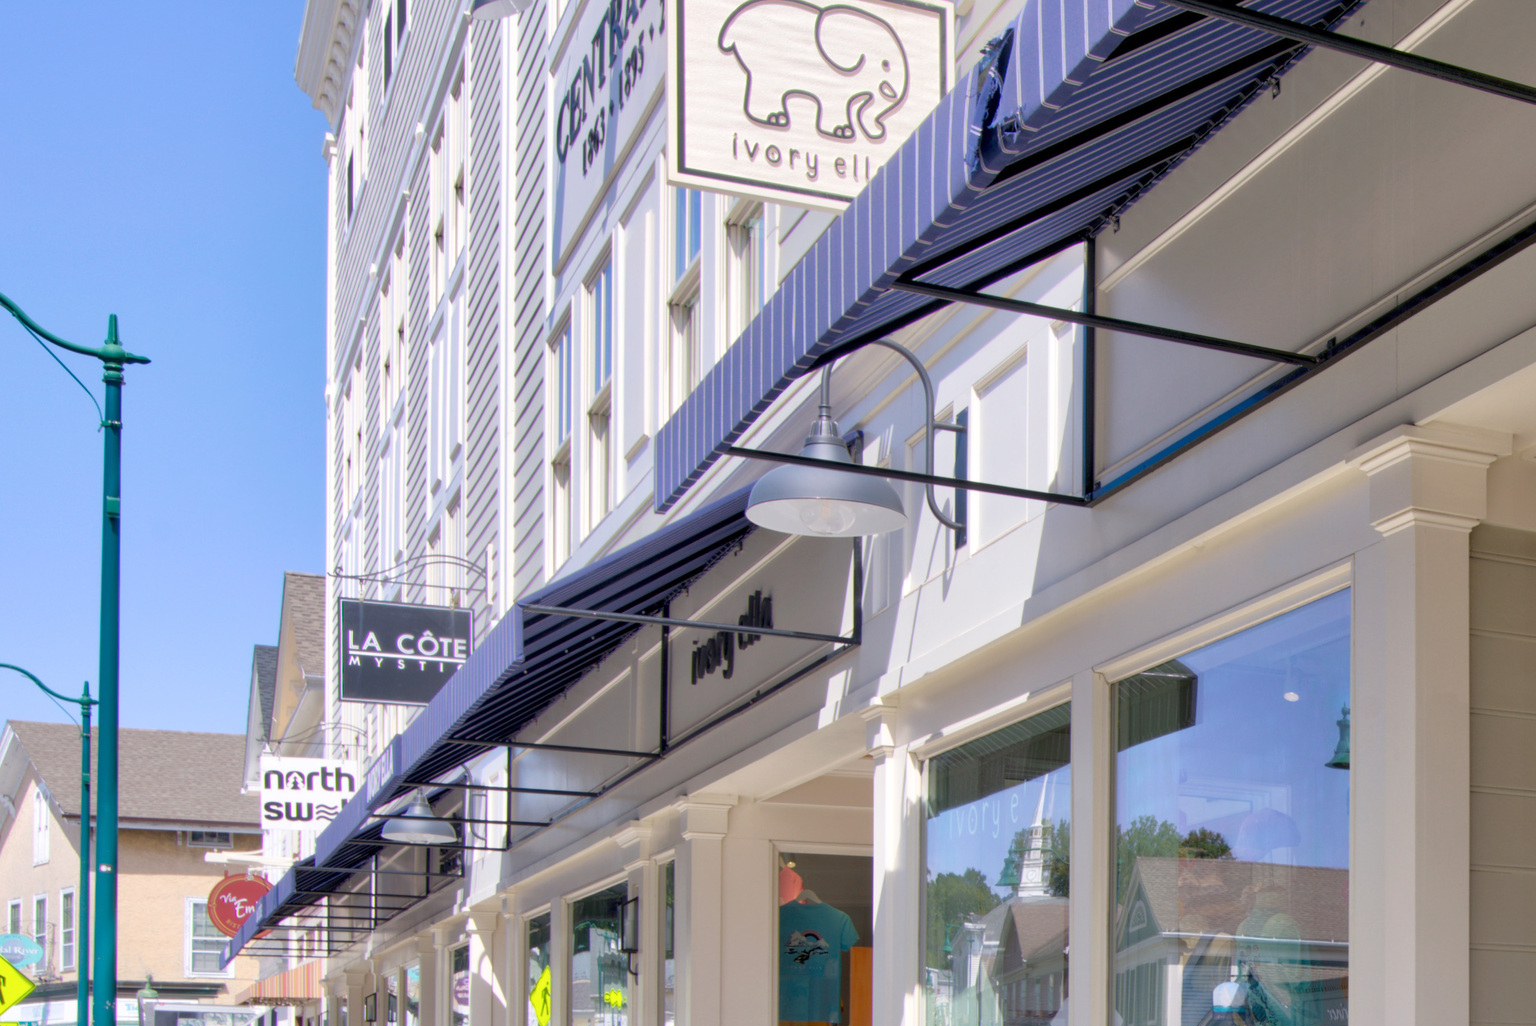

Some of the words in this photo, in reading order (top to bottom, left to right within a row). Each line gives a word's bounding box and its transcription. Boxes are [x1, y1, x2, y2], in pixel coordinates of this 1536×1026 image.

[732, 132, 818, 182] ivory
[348, 630, 382, 652] LA
[396, 630, 467, 659] CÔTE
[264, 766, 355, 792] north
[219, 893, 237, 903] Via
[234, 898, 258, 918] Em
